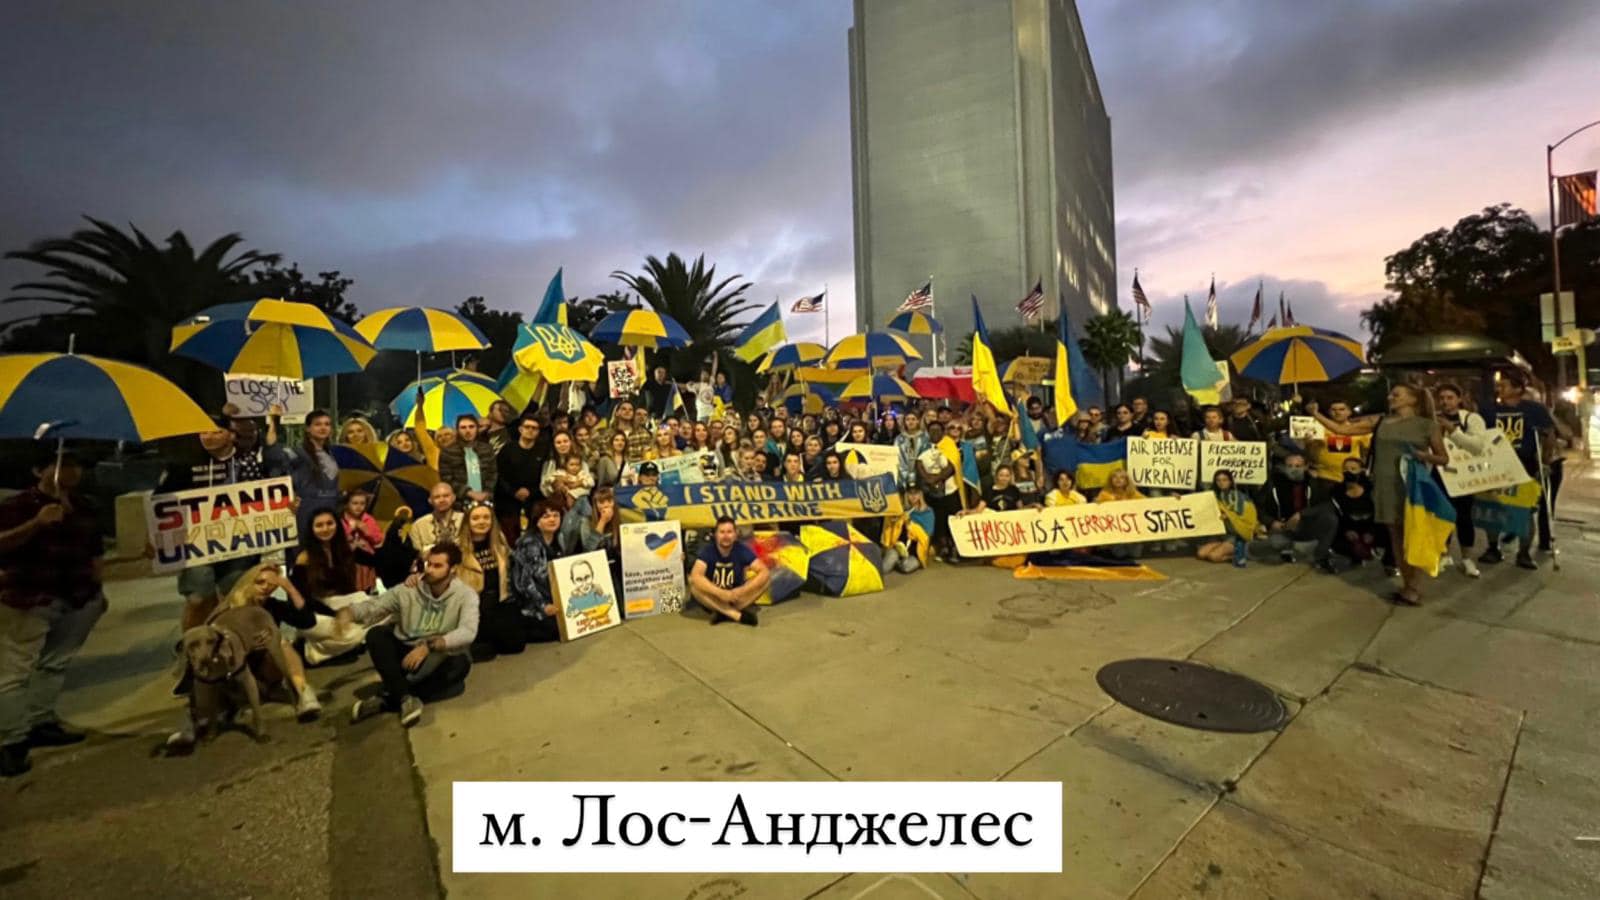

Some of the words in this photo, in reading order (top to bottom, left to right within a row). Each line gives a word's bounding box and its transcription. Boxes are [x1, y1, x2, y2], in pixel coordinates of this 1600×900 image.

[1130, 440, 1149, 455] AIR
[1153, 440, 1193, 456] DEFENSE
[1152, 456, 1175, 467] FOR
[1132, 468, 1193, 486] UKRAINE
[684, 486, 692, 504] I
[700, 485, 777, 503] STAND
[783, 482, 842, 500] WITH
[154, 484, 291, 531] STAND
[711, 502, 823, 521] UKRAINE
[968, 519, 1027, 551] #RUSSIA
[1031, 520, 1047, 544] IS
[1050, 518, 1068, 544] A
[1066, 513, 1141, 539] TERRORIST
[1144, 508, 1195, 533] STATE
